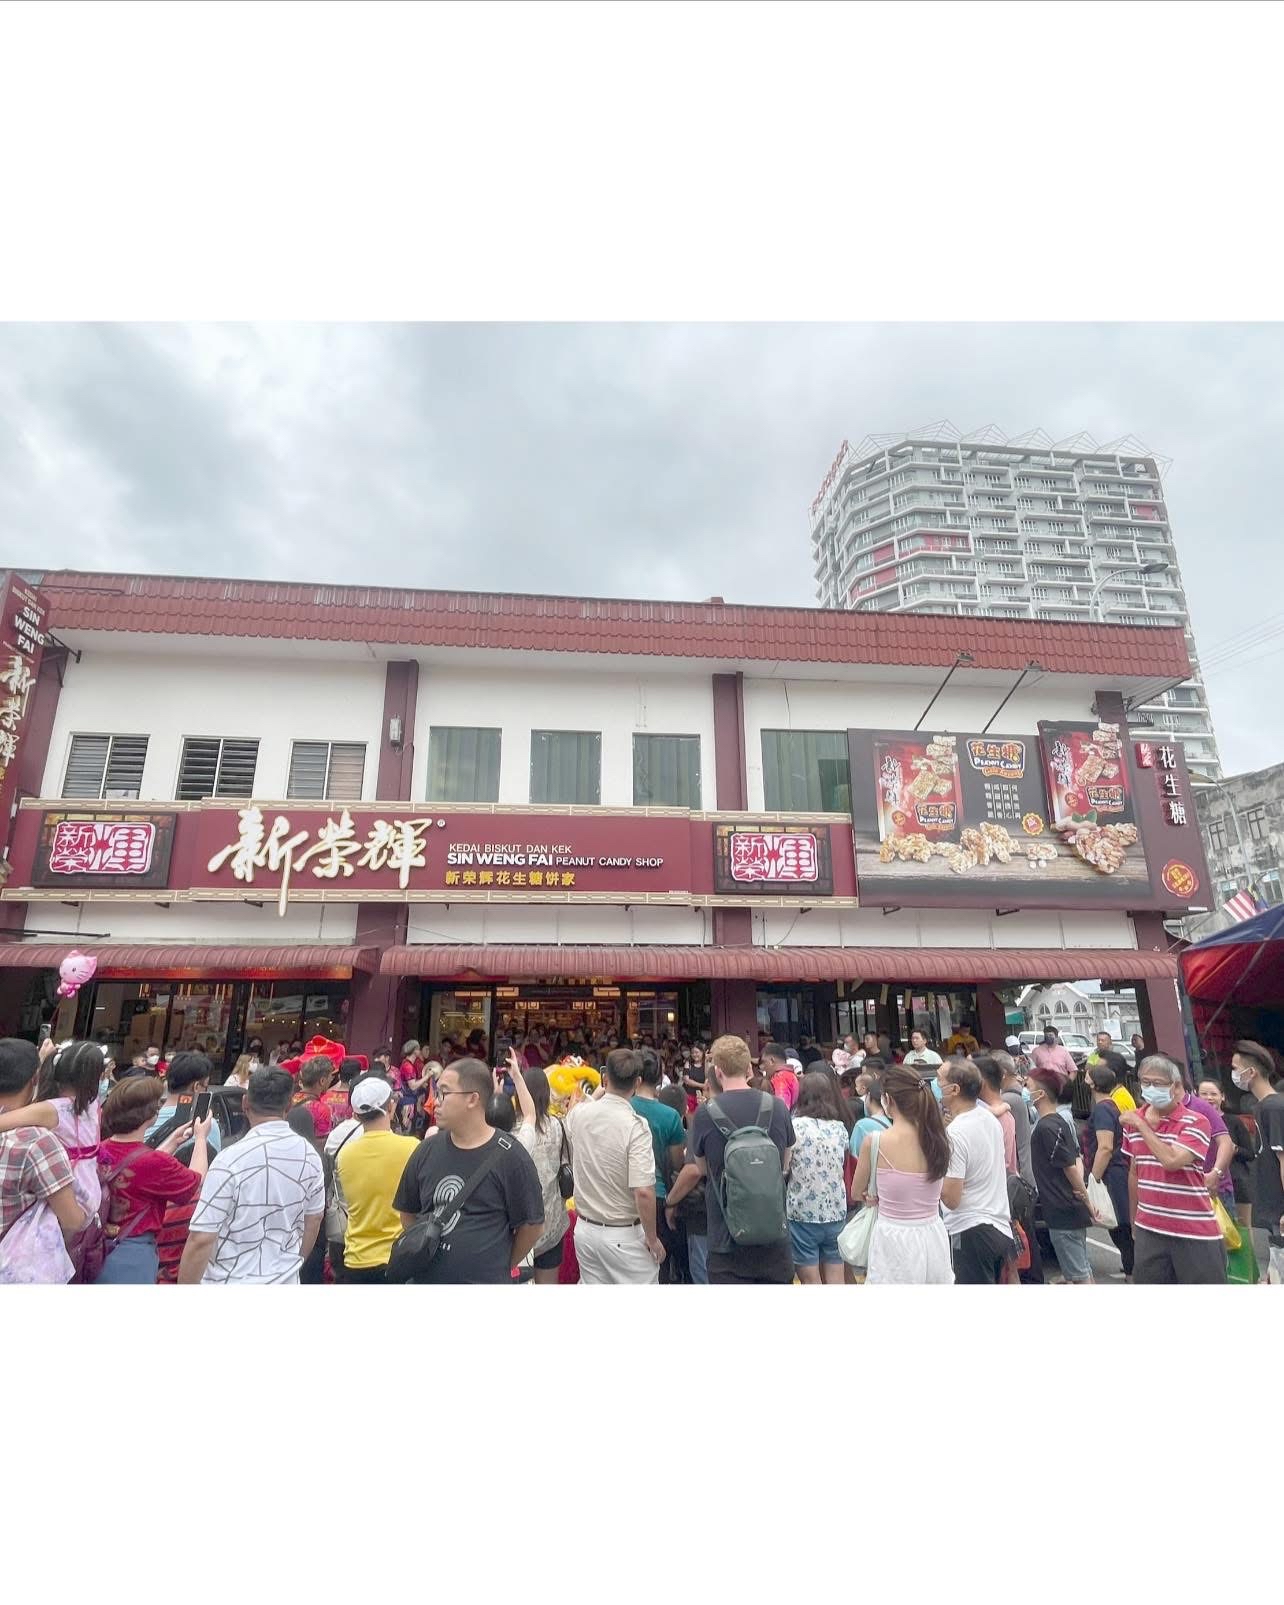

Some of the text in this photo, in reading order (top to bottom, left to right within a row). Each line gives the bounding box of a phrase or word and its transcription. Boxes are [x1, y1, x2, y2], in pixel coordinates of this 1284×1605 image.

[23, 606, 40, 626] SIN
[15, 614, 44, 645] WENG
[18, 634, 34, 654] FAI
[1159, 746, 1187, 825] 花生糖
[449, 844, 572, 854] KEDAI BISKUT DAN KEK
[447, 853, 664, 867] SIN WENG FAI PEANUT CANDY SHOP
